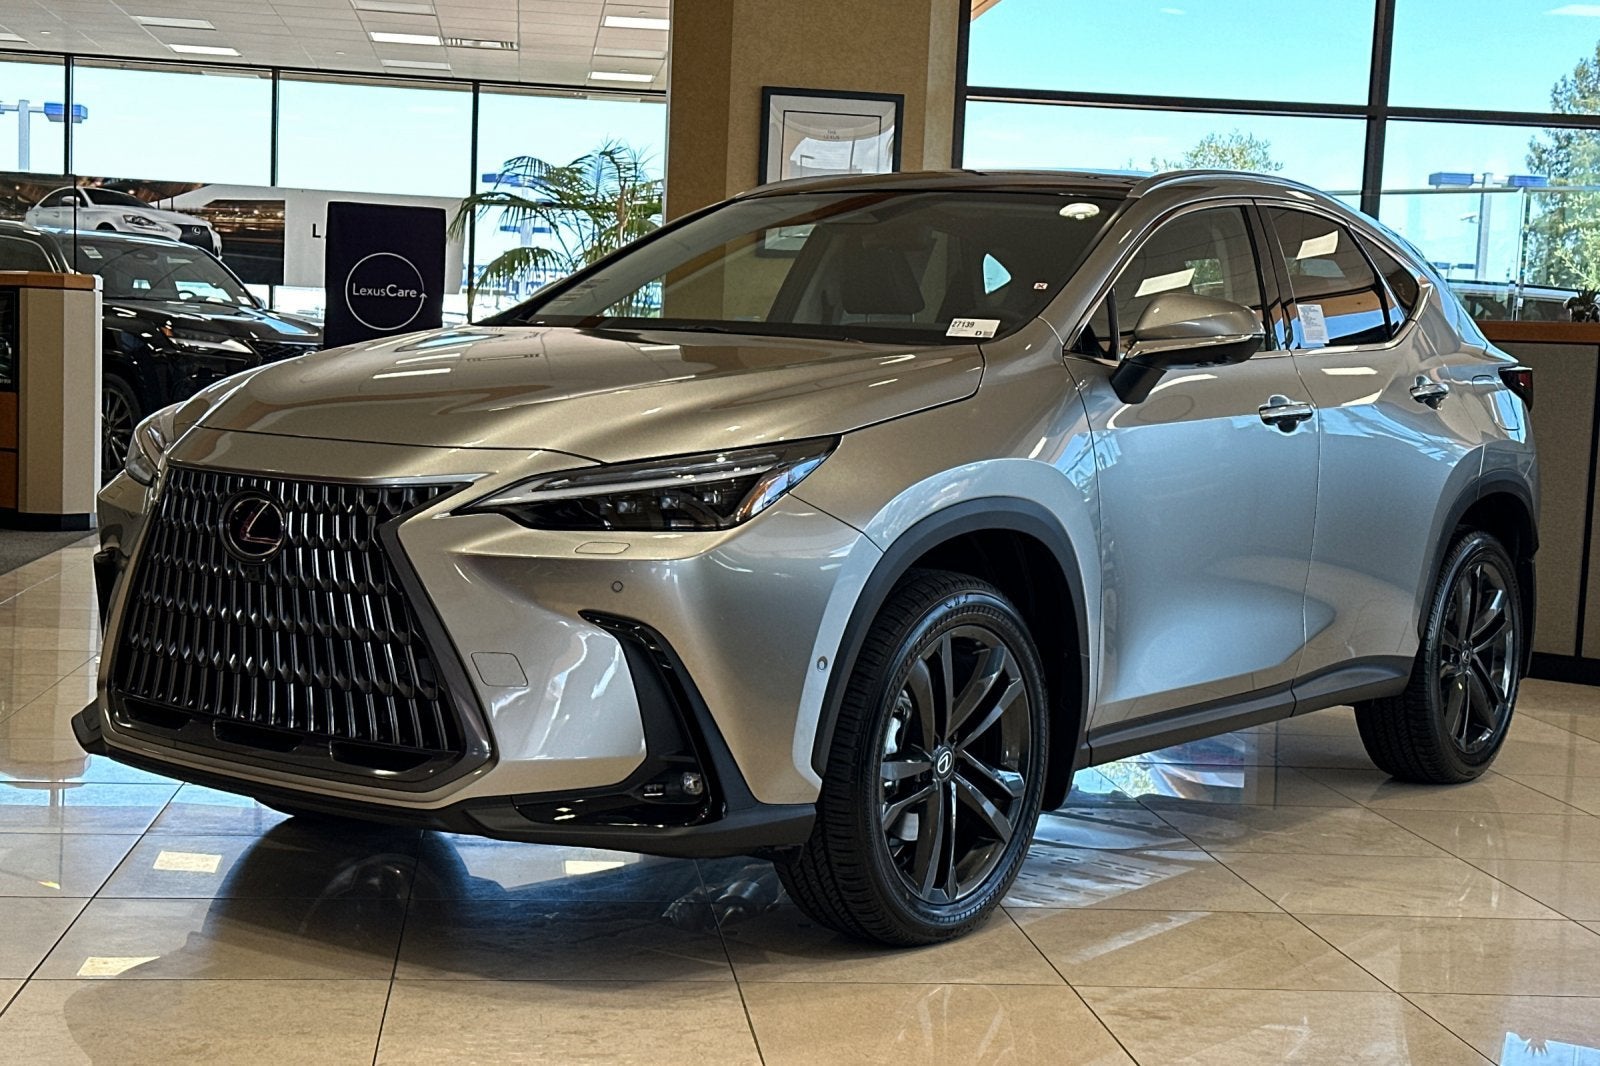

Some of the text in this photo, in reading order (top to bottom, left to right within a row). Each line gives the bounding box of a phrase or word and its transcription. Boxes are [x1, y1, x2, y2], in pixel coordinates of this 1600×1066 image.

[312, 223, 326, 238] L
[352, 282, 417, 298] LexusCare
[951, 320, 975, 328] 27139
